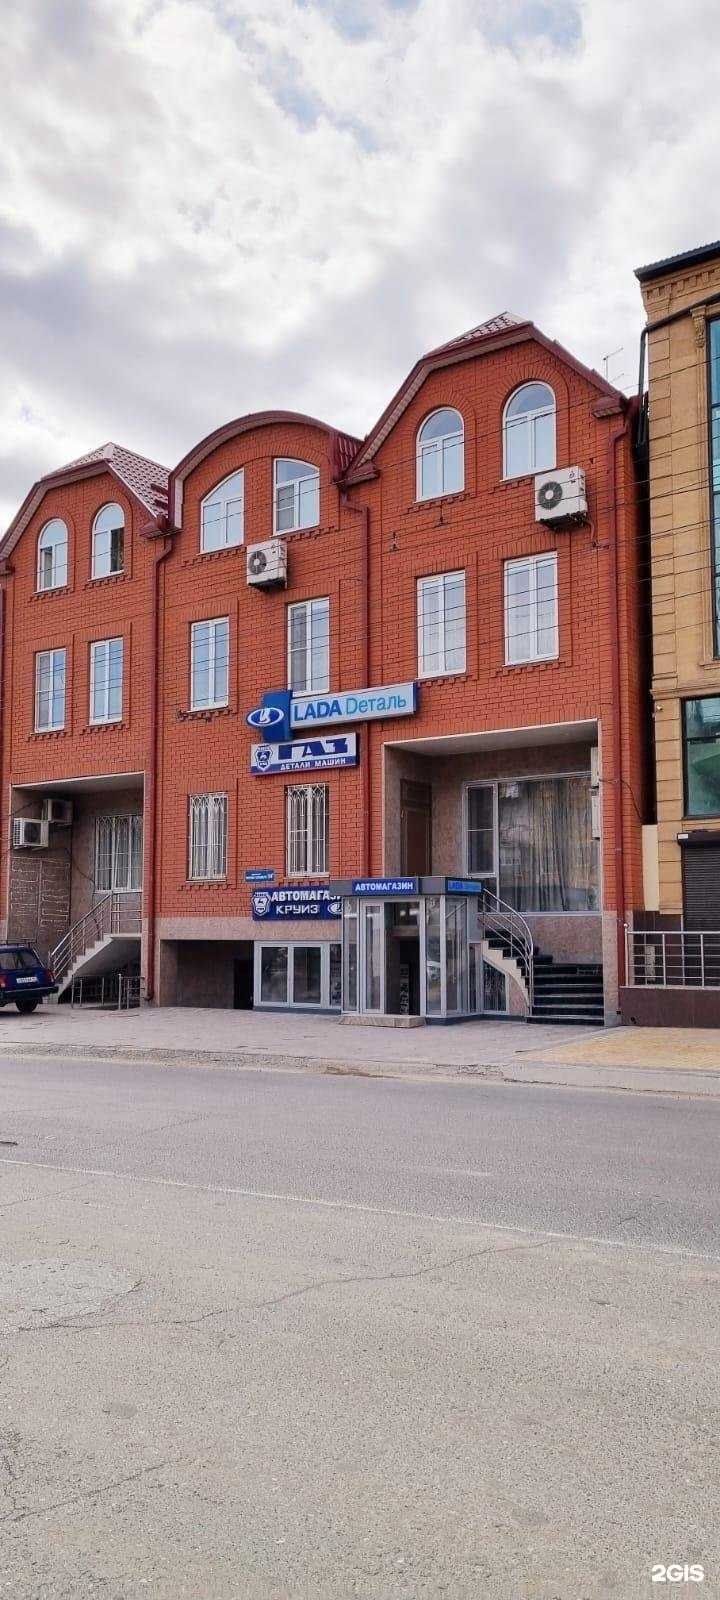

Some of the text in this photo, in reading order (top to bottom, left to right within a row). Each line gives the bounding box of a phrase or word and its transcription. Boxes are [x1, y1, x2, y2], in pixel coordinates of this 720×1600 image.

[294, 699, 342, 722] LADA
[277, 737, 348, 760] ГАЗ
[280, 757, 346, 771] ДЕТАЛИ МАШИН
[355, 881, 414, 892] АВТОМАГАЗИН
[271, 890, 341, 902] АВТОМАГА
[276, 904, 319, 915] КРУИЗ
